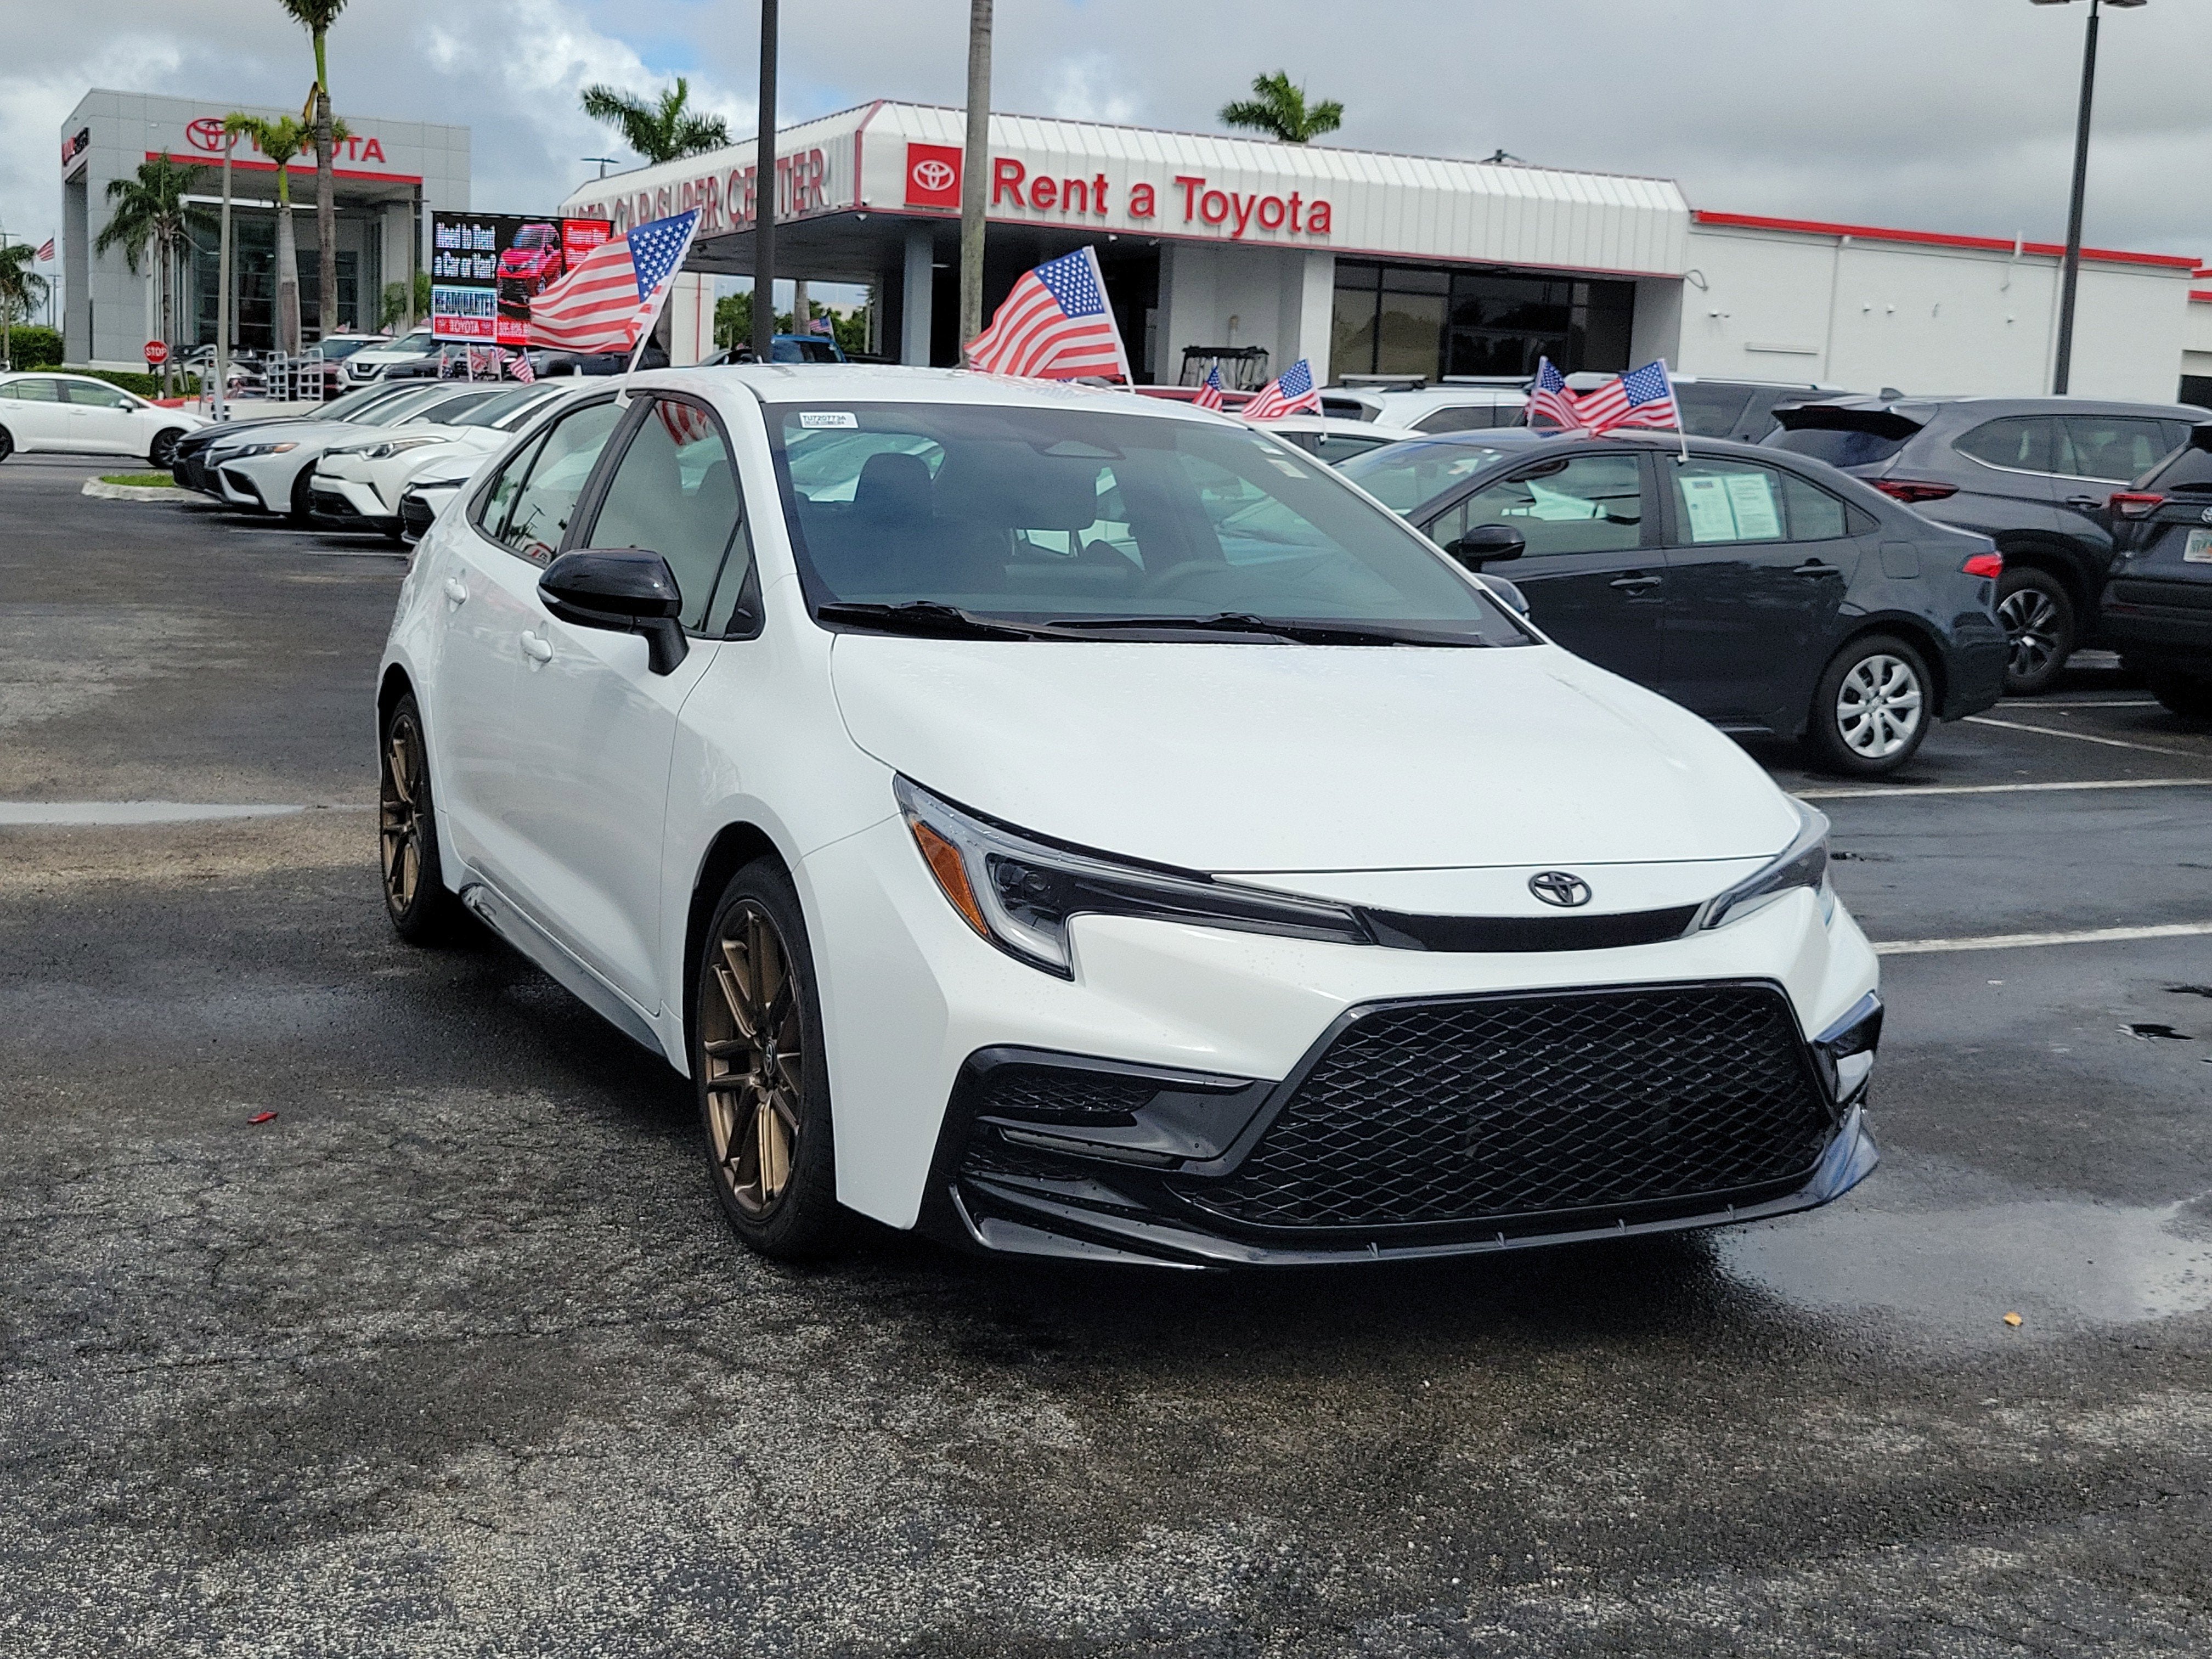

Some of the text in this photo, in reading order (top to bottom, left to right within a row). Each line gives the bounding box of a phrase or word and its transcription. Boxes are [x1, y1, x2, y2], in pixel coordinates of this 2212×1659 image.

[991, 157, 1332, 239] Rent a Toyota
[145, 346, 167, 356] STOP
